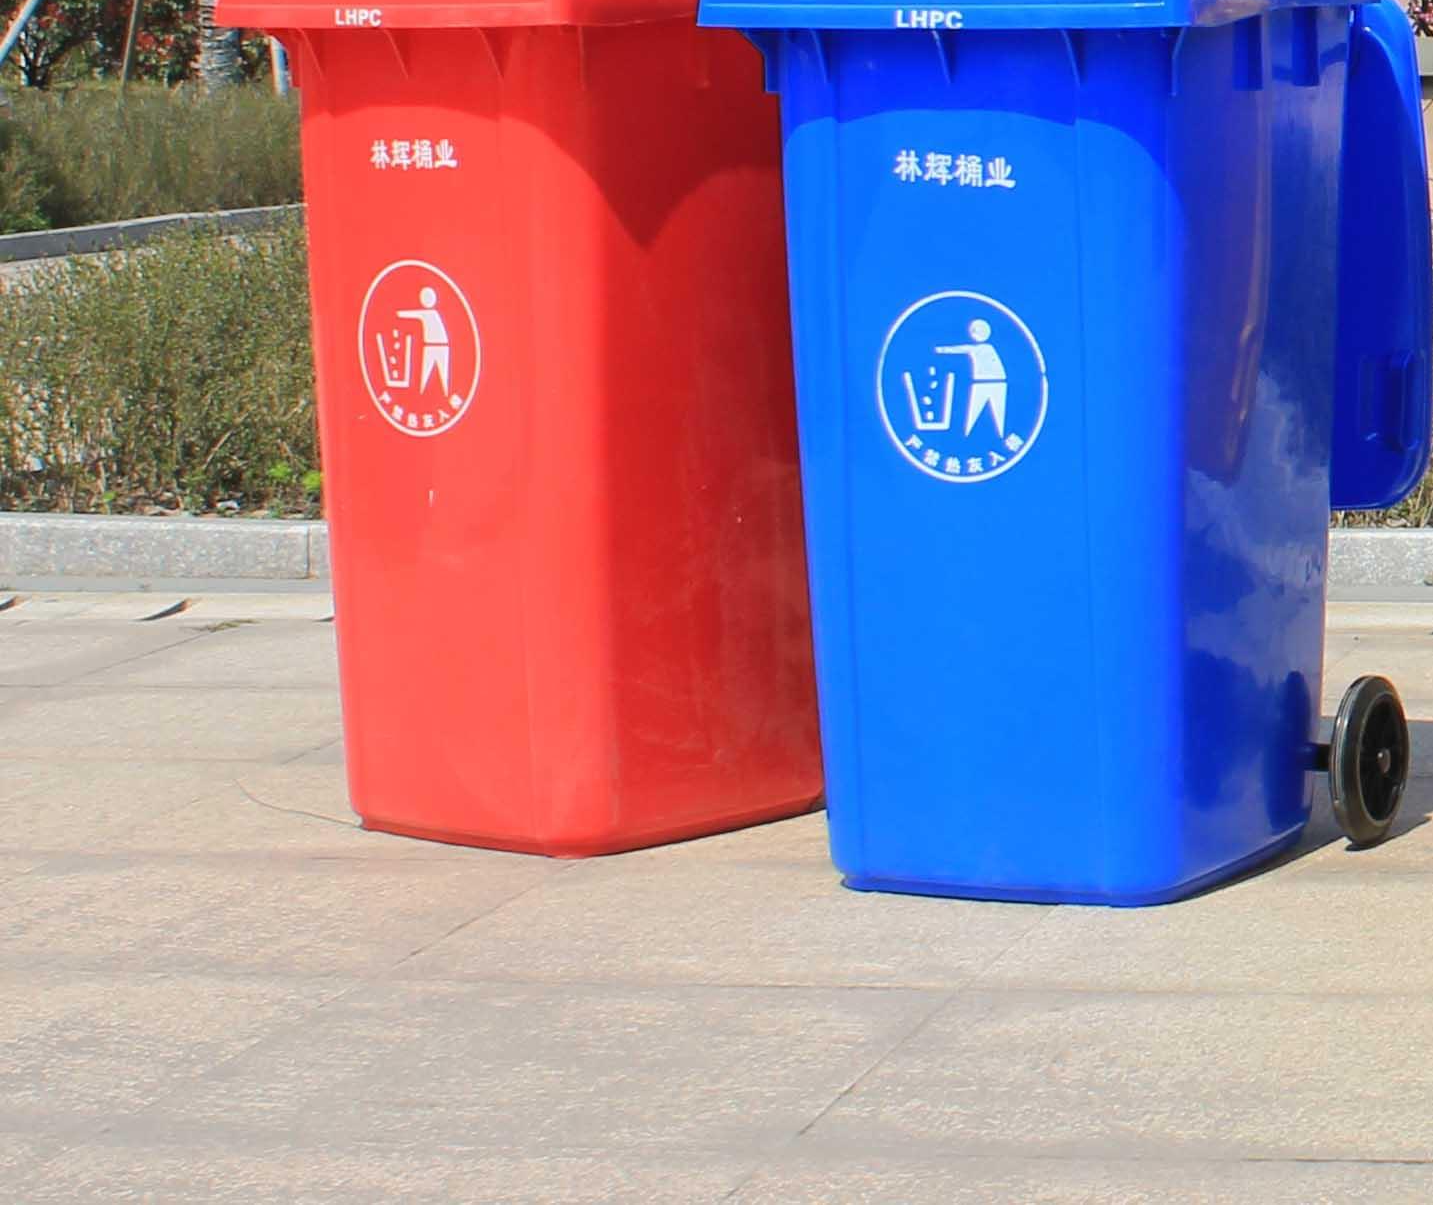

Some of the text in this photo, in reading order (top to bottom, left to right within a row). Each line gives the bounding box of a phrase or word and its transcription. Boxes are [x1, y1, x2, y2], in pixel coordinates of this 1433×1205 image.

[335, 8, 382, 27] LHPC
[895, 10, 963, 29] LHPC
[371, 140, 457, 169] 林辉桶业
[893, 151, 1016, 187] 林辉桶业
